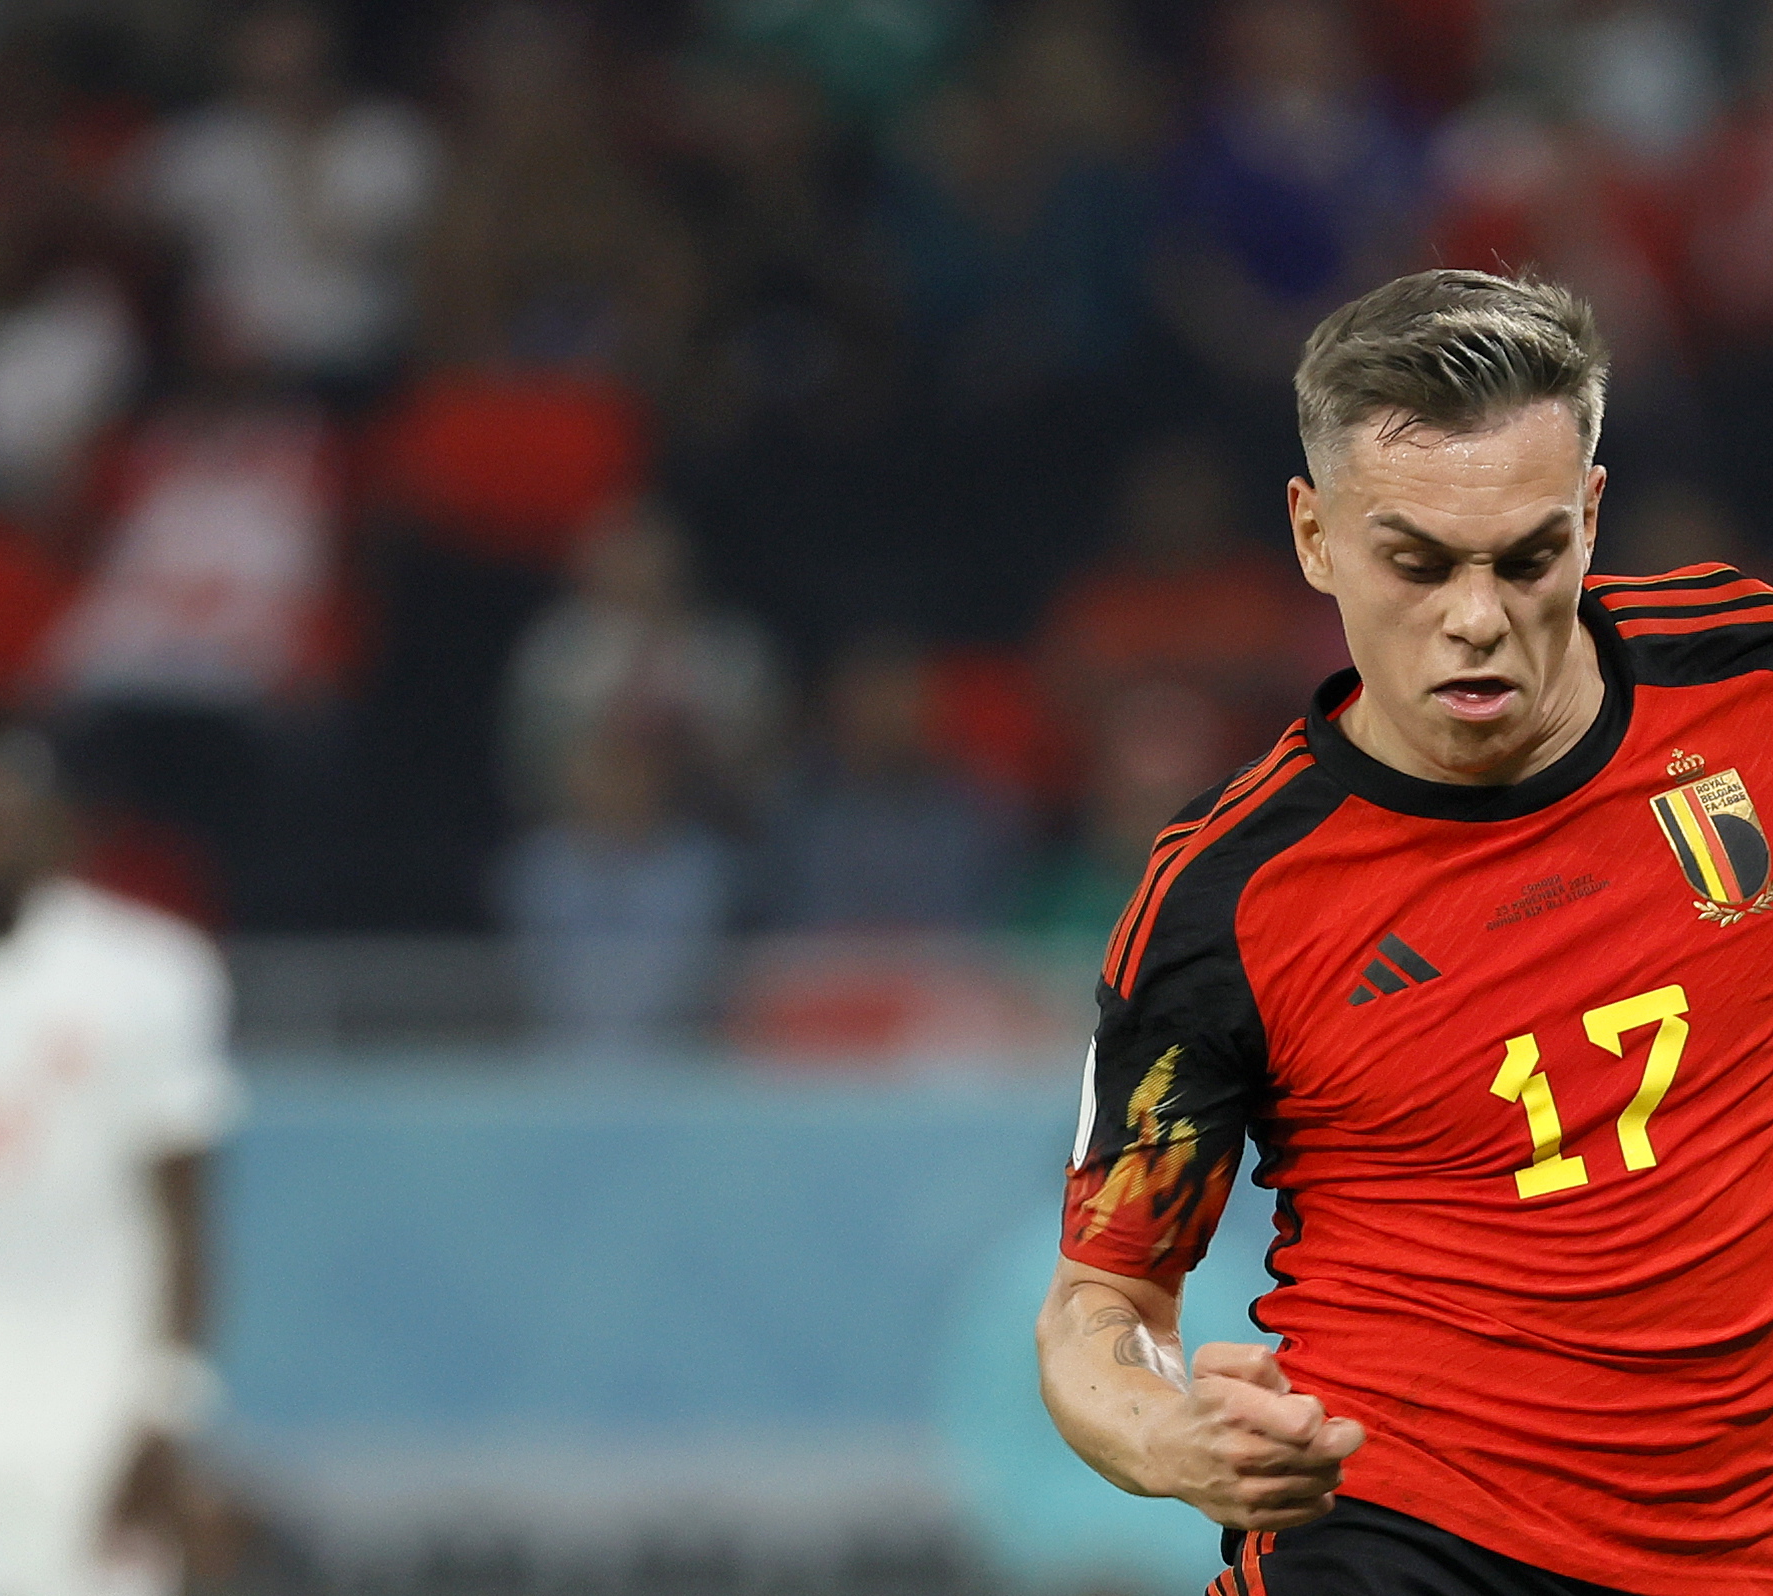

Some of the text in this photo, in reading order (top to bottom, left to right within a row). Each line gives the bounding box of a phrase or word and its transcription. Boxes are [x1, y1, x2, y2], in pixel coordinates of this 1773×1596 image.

[1695, 776, 1727, 795] ROYAL
[1699, 782, 1743, 804] BELGIAN
[1489, 984, 1690, 1200] 17
